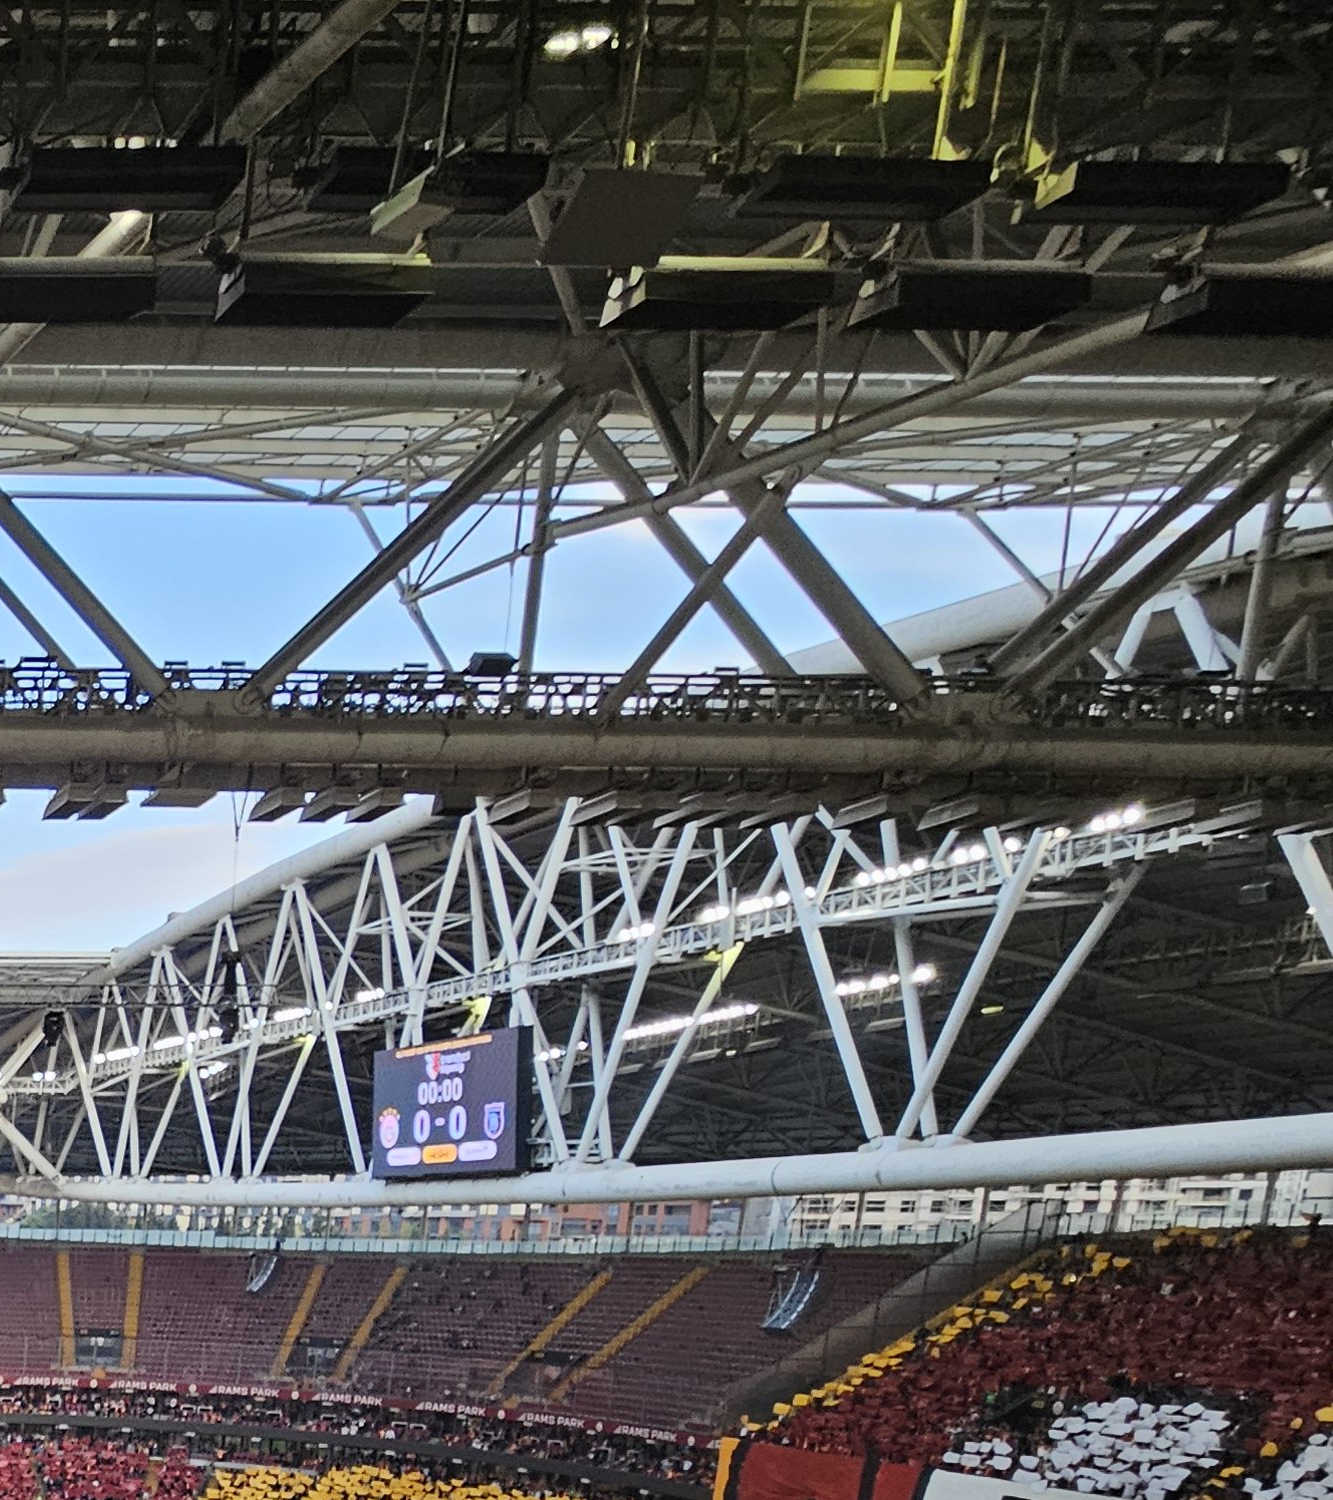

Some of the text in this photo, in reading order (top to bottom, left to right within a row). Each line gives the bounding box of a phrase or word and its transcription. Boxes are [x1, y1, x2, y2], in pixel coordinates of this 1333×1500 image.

[417, 1077, 463, 1106] 00:00
[21, 1376, 79, 1388] RAMS PARK
[117, 1380, 177, 1393] RAMS PARK
[217, 1386, 280, 1399] RAMS PARK
[320, 1392, 382, 1407] RAMS PARK
[424, 1401, 486, 1417] RAMS PARK
[526, 1413, 585, 1429] RAMS PARK
[622, 1424, 677, 1442] RAMS PARK
